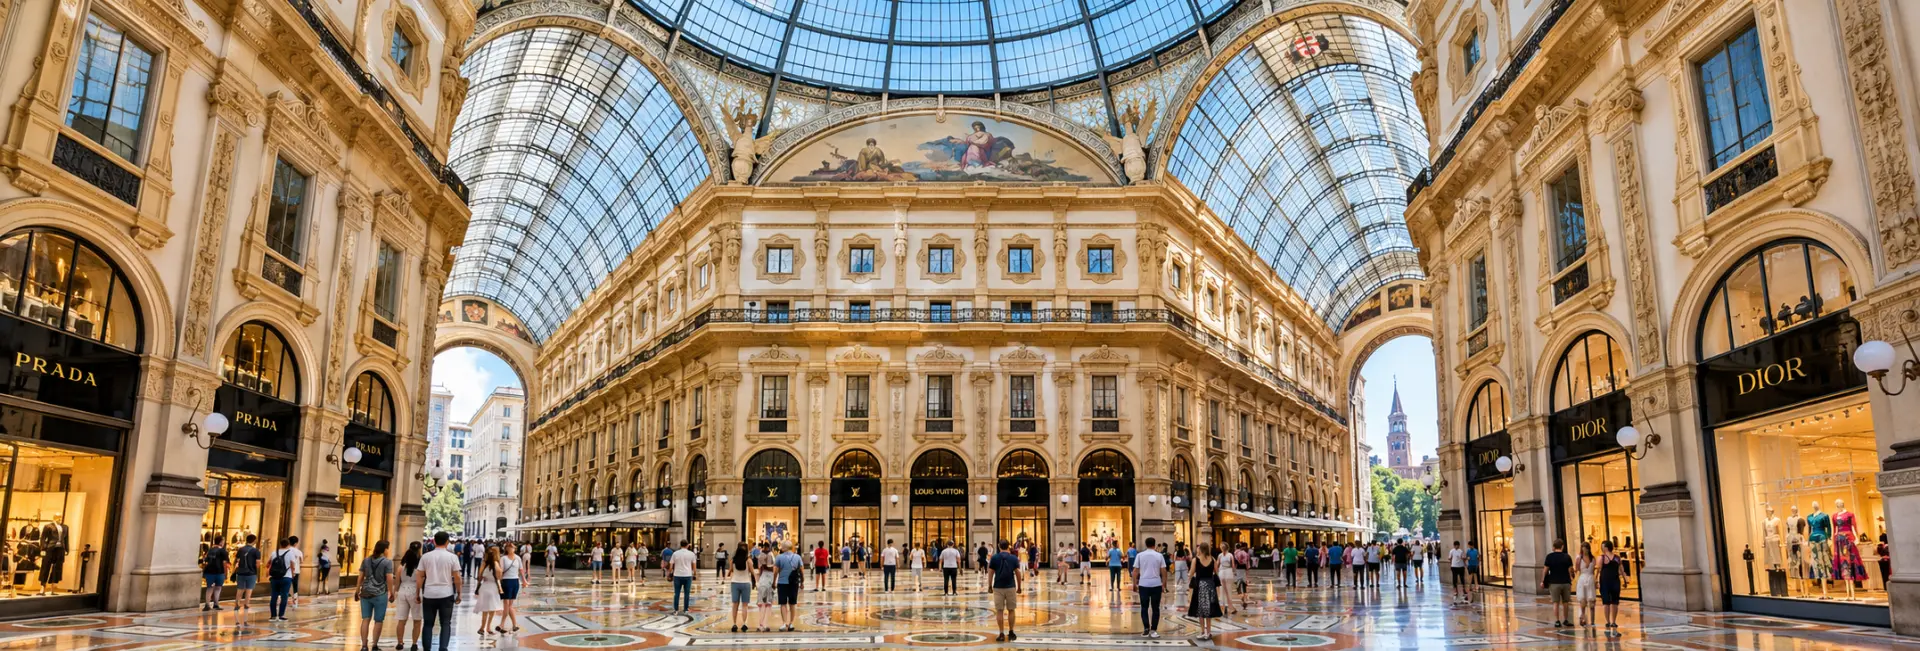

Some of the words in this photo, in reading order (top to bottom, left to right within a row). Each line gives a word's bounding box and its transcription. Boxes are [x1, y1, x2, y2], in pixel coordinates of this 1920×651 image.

[15, 352, 98, 387] PRADA
[1738, 357, 1806, 396] DIOR
[236, 411, 277, 431] PRADA
[1571, 417, 1607, 442] DIOR
[1479, 449, 1499, 466] DIOR
[1095, 488, 1117, 496] DIOR
